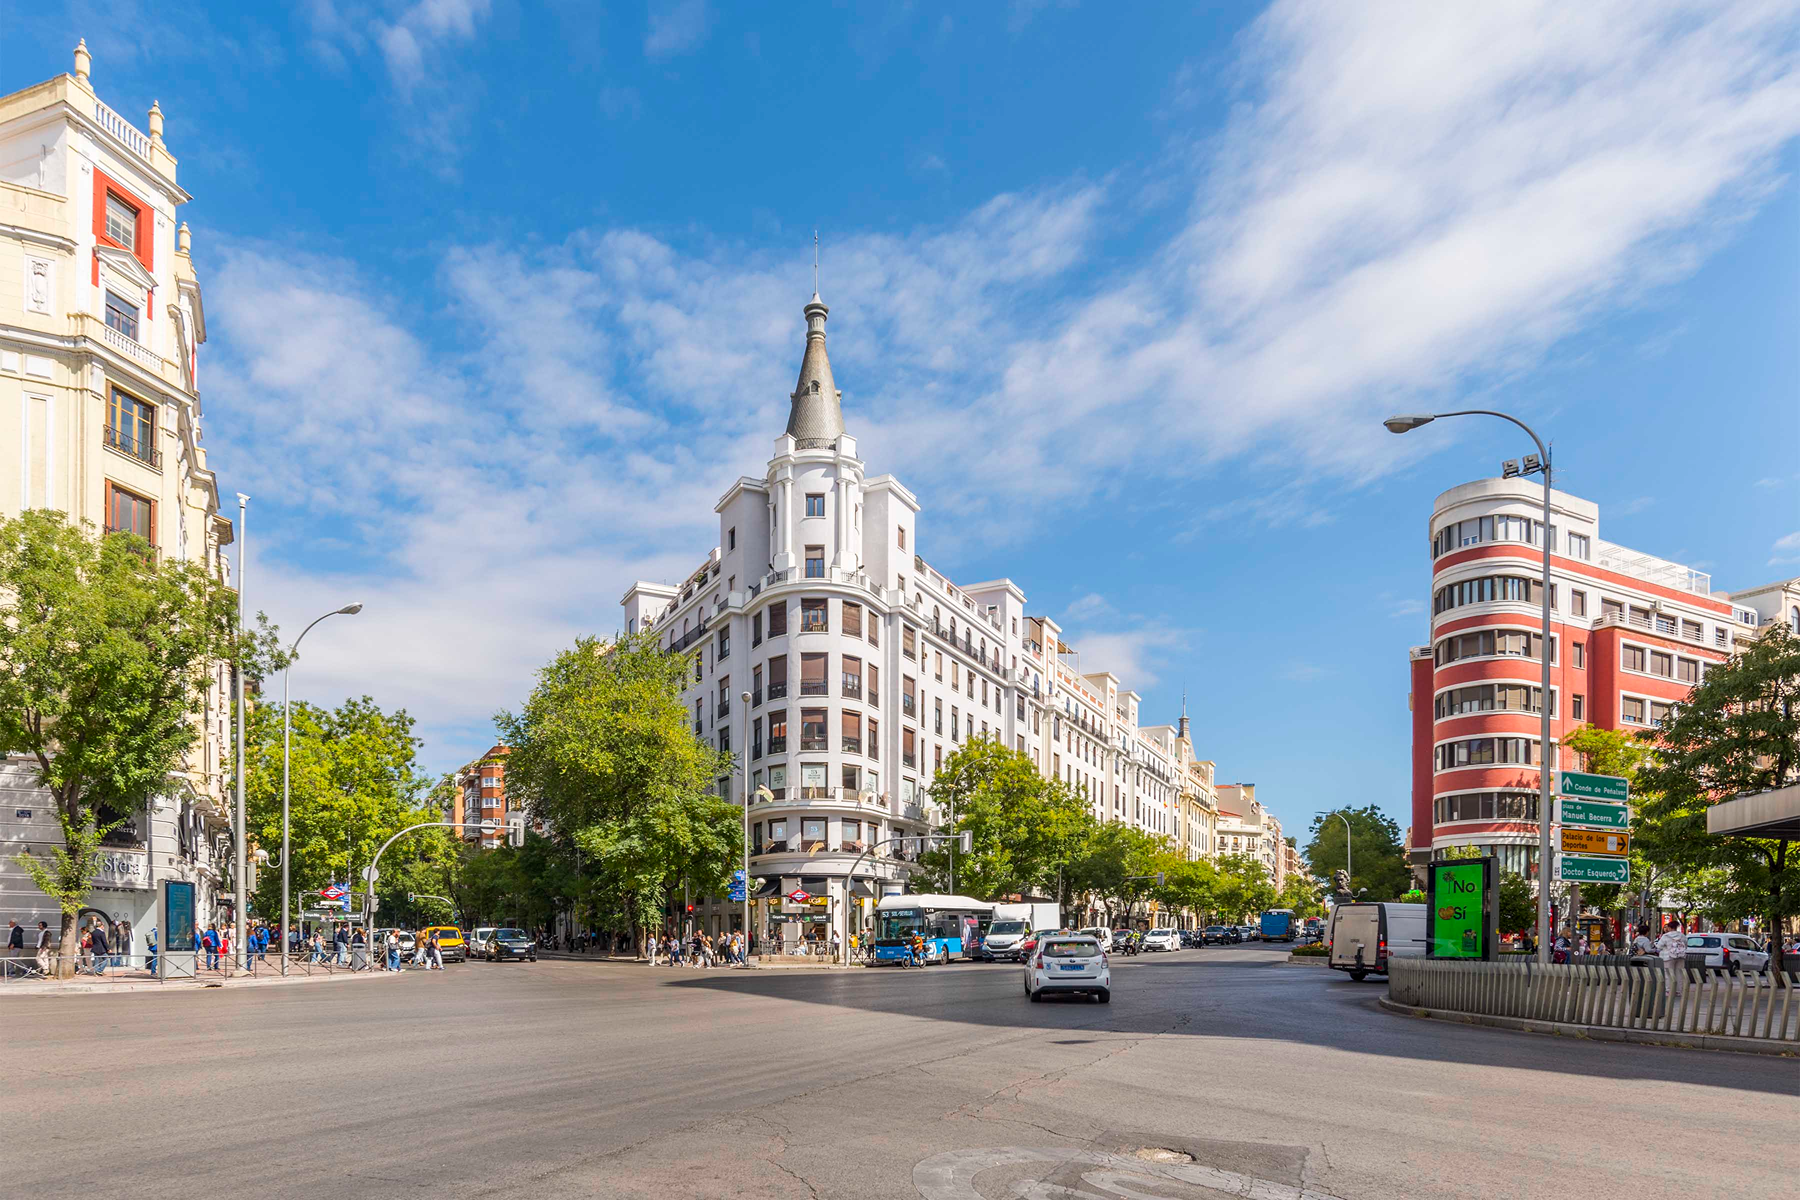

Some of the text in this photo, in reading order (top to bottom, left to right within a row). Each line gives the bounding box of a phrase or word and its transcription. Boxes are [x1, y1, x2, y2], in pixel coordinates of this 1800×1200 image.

[1574, 783, 1592, 792] Conde
[1603, 787, 1626, 796] Peñalver
[1562, 810, 1612, 823] Manuel Becerra
[1562, 832, 1583, 841] Palacio
[1562, 841, 1588, 850] Deportes
[1562, 867, 1584, 876] Doctor
[1587, 869, 1617, 878] Esquerdo
[1454, 880, 1475, 893] No
[1454, 906, 1467, 920] Sí
